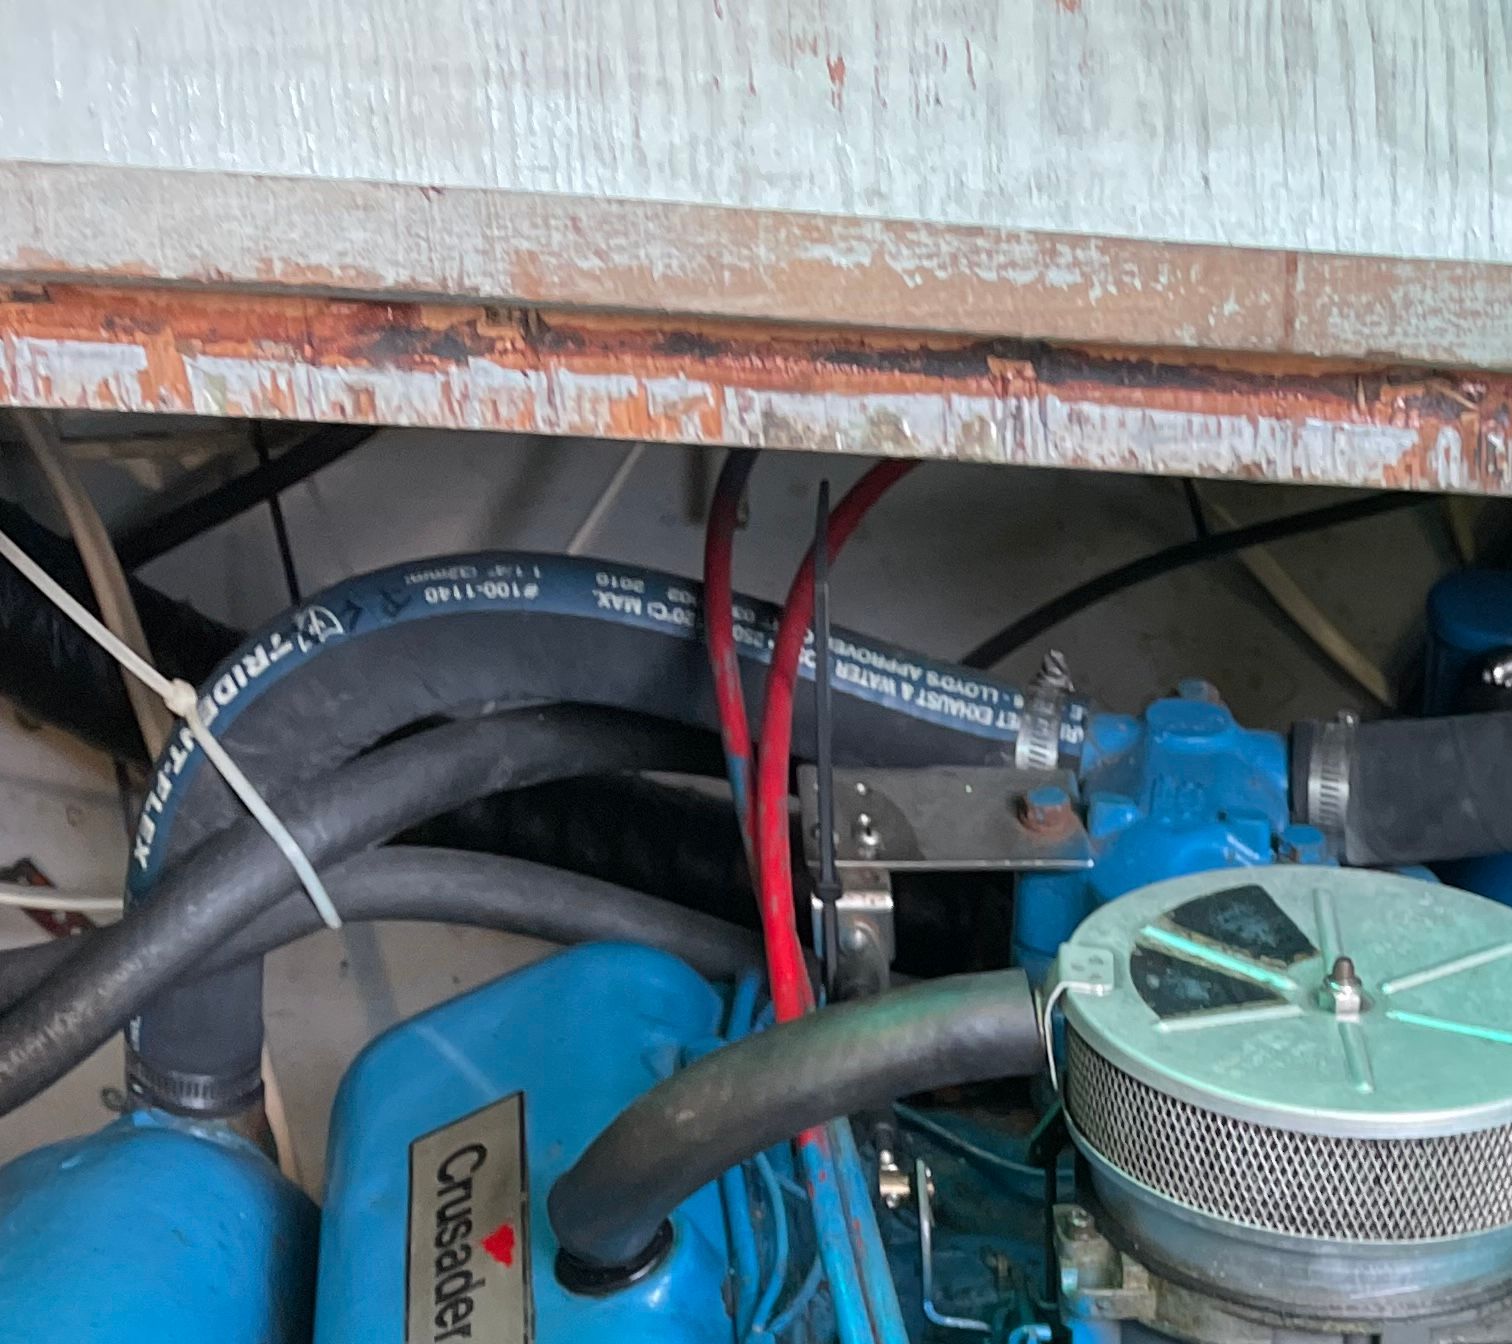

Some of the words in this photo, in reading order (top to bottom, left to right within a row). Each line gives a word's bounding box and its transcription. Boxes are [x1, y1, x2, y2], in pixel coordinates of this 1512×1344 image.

[826, 636, 921, 683] APPROVE
[834, 661, 898, 700] WATER
[915, 689, 995, 729] EXHAUST
[433, 1141, 488, 1344] Crusader
